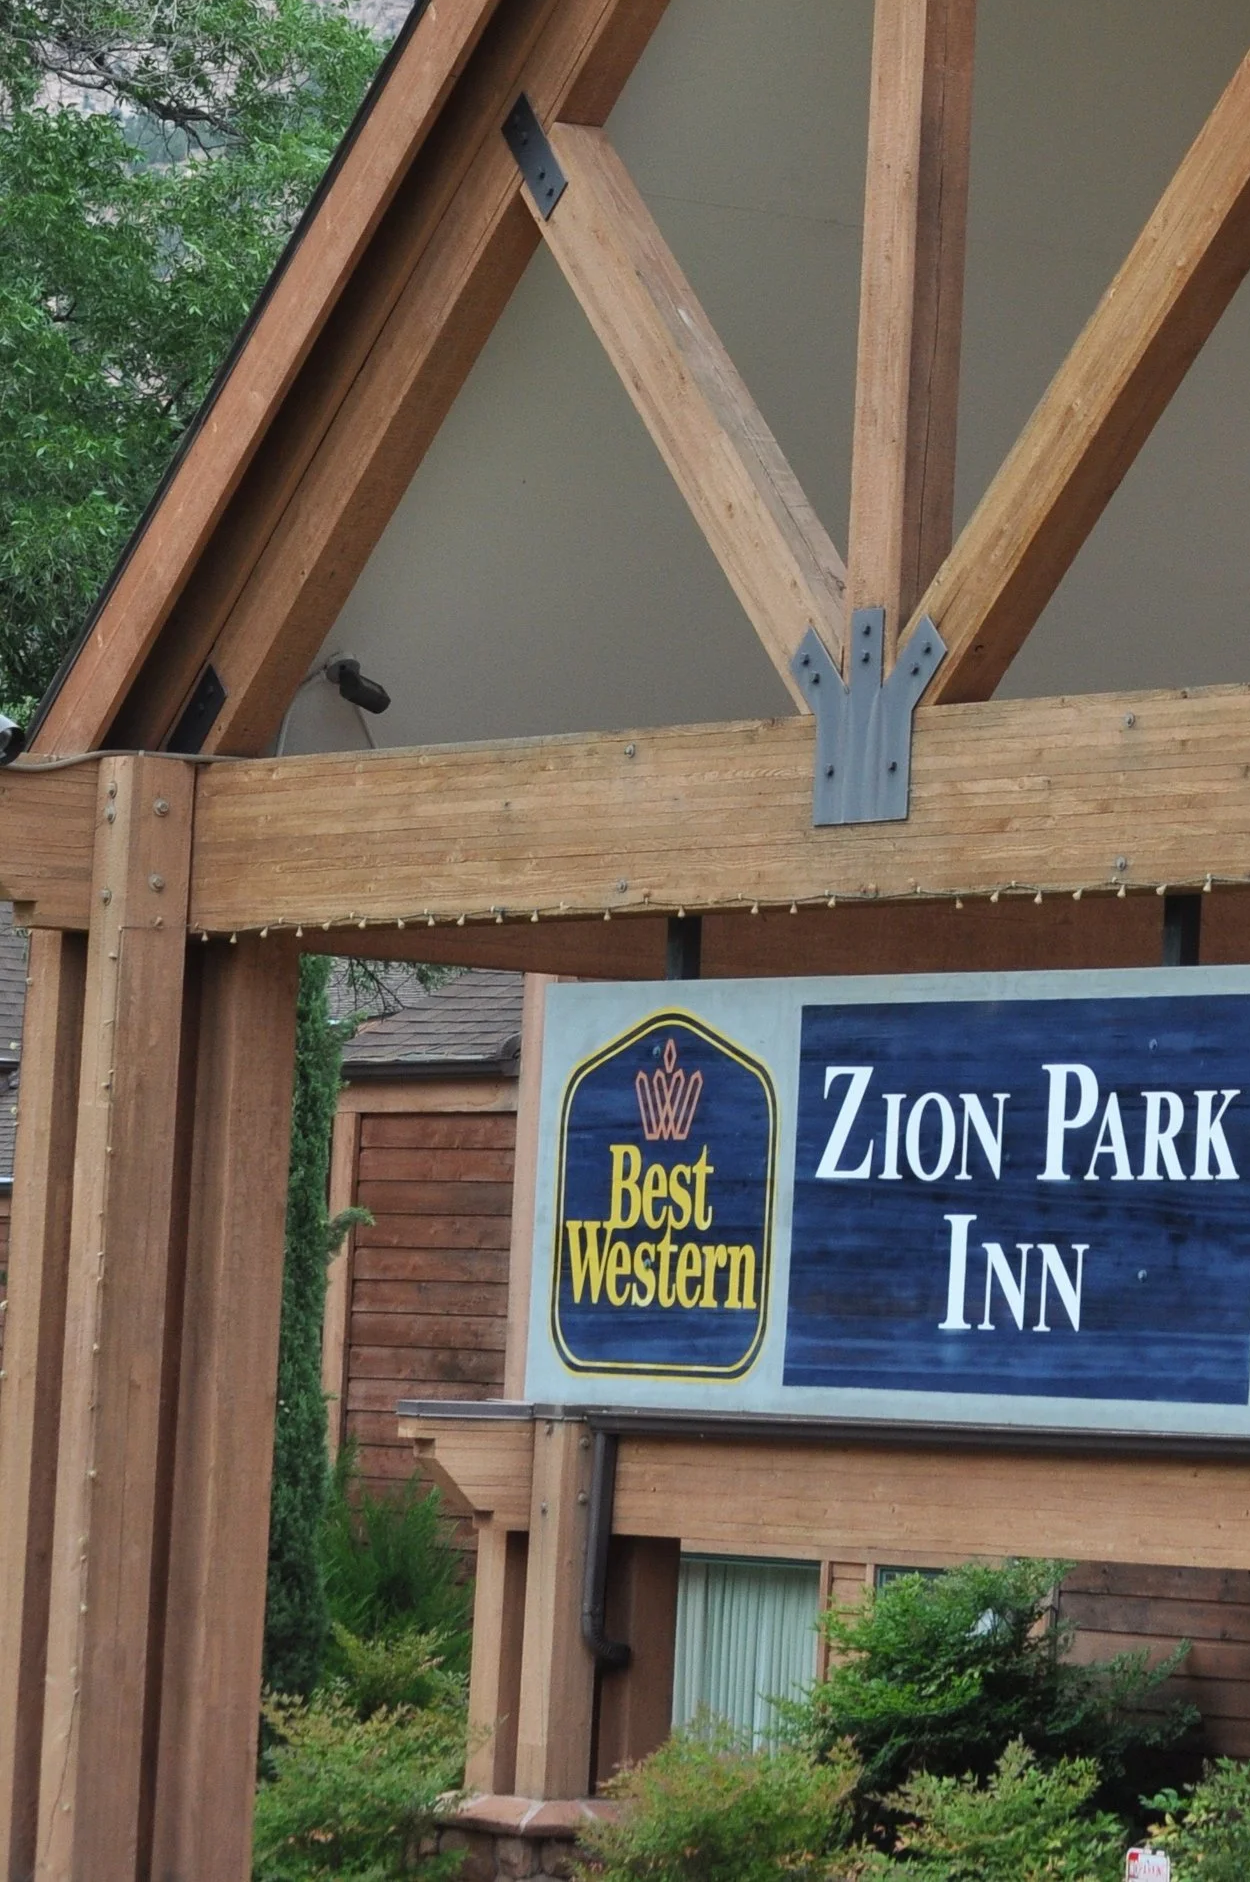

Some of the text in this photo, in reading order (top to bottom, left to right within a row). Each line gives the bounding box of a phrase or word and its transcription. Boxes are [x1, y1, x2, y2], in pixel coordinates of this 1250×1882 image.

[815, 1063, 1240, 1181] ZION PARK
[608, 1143, 714, 1232] Best
[565, 1220, 757, 1310] Western
[937, 1213, 1089, 1332] INN
